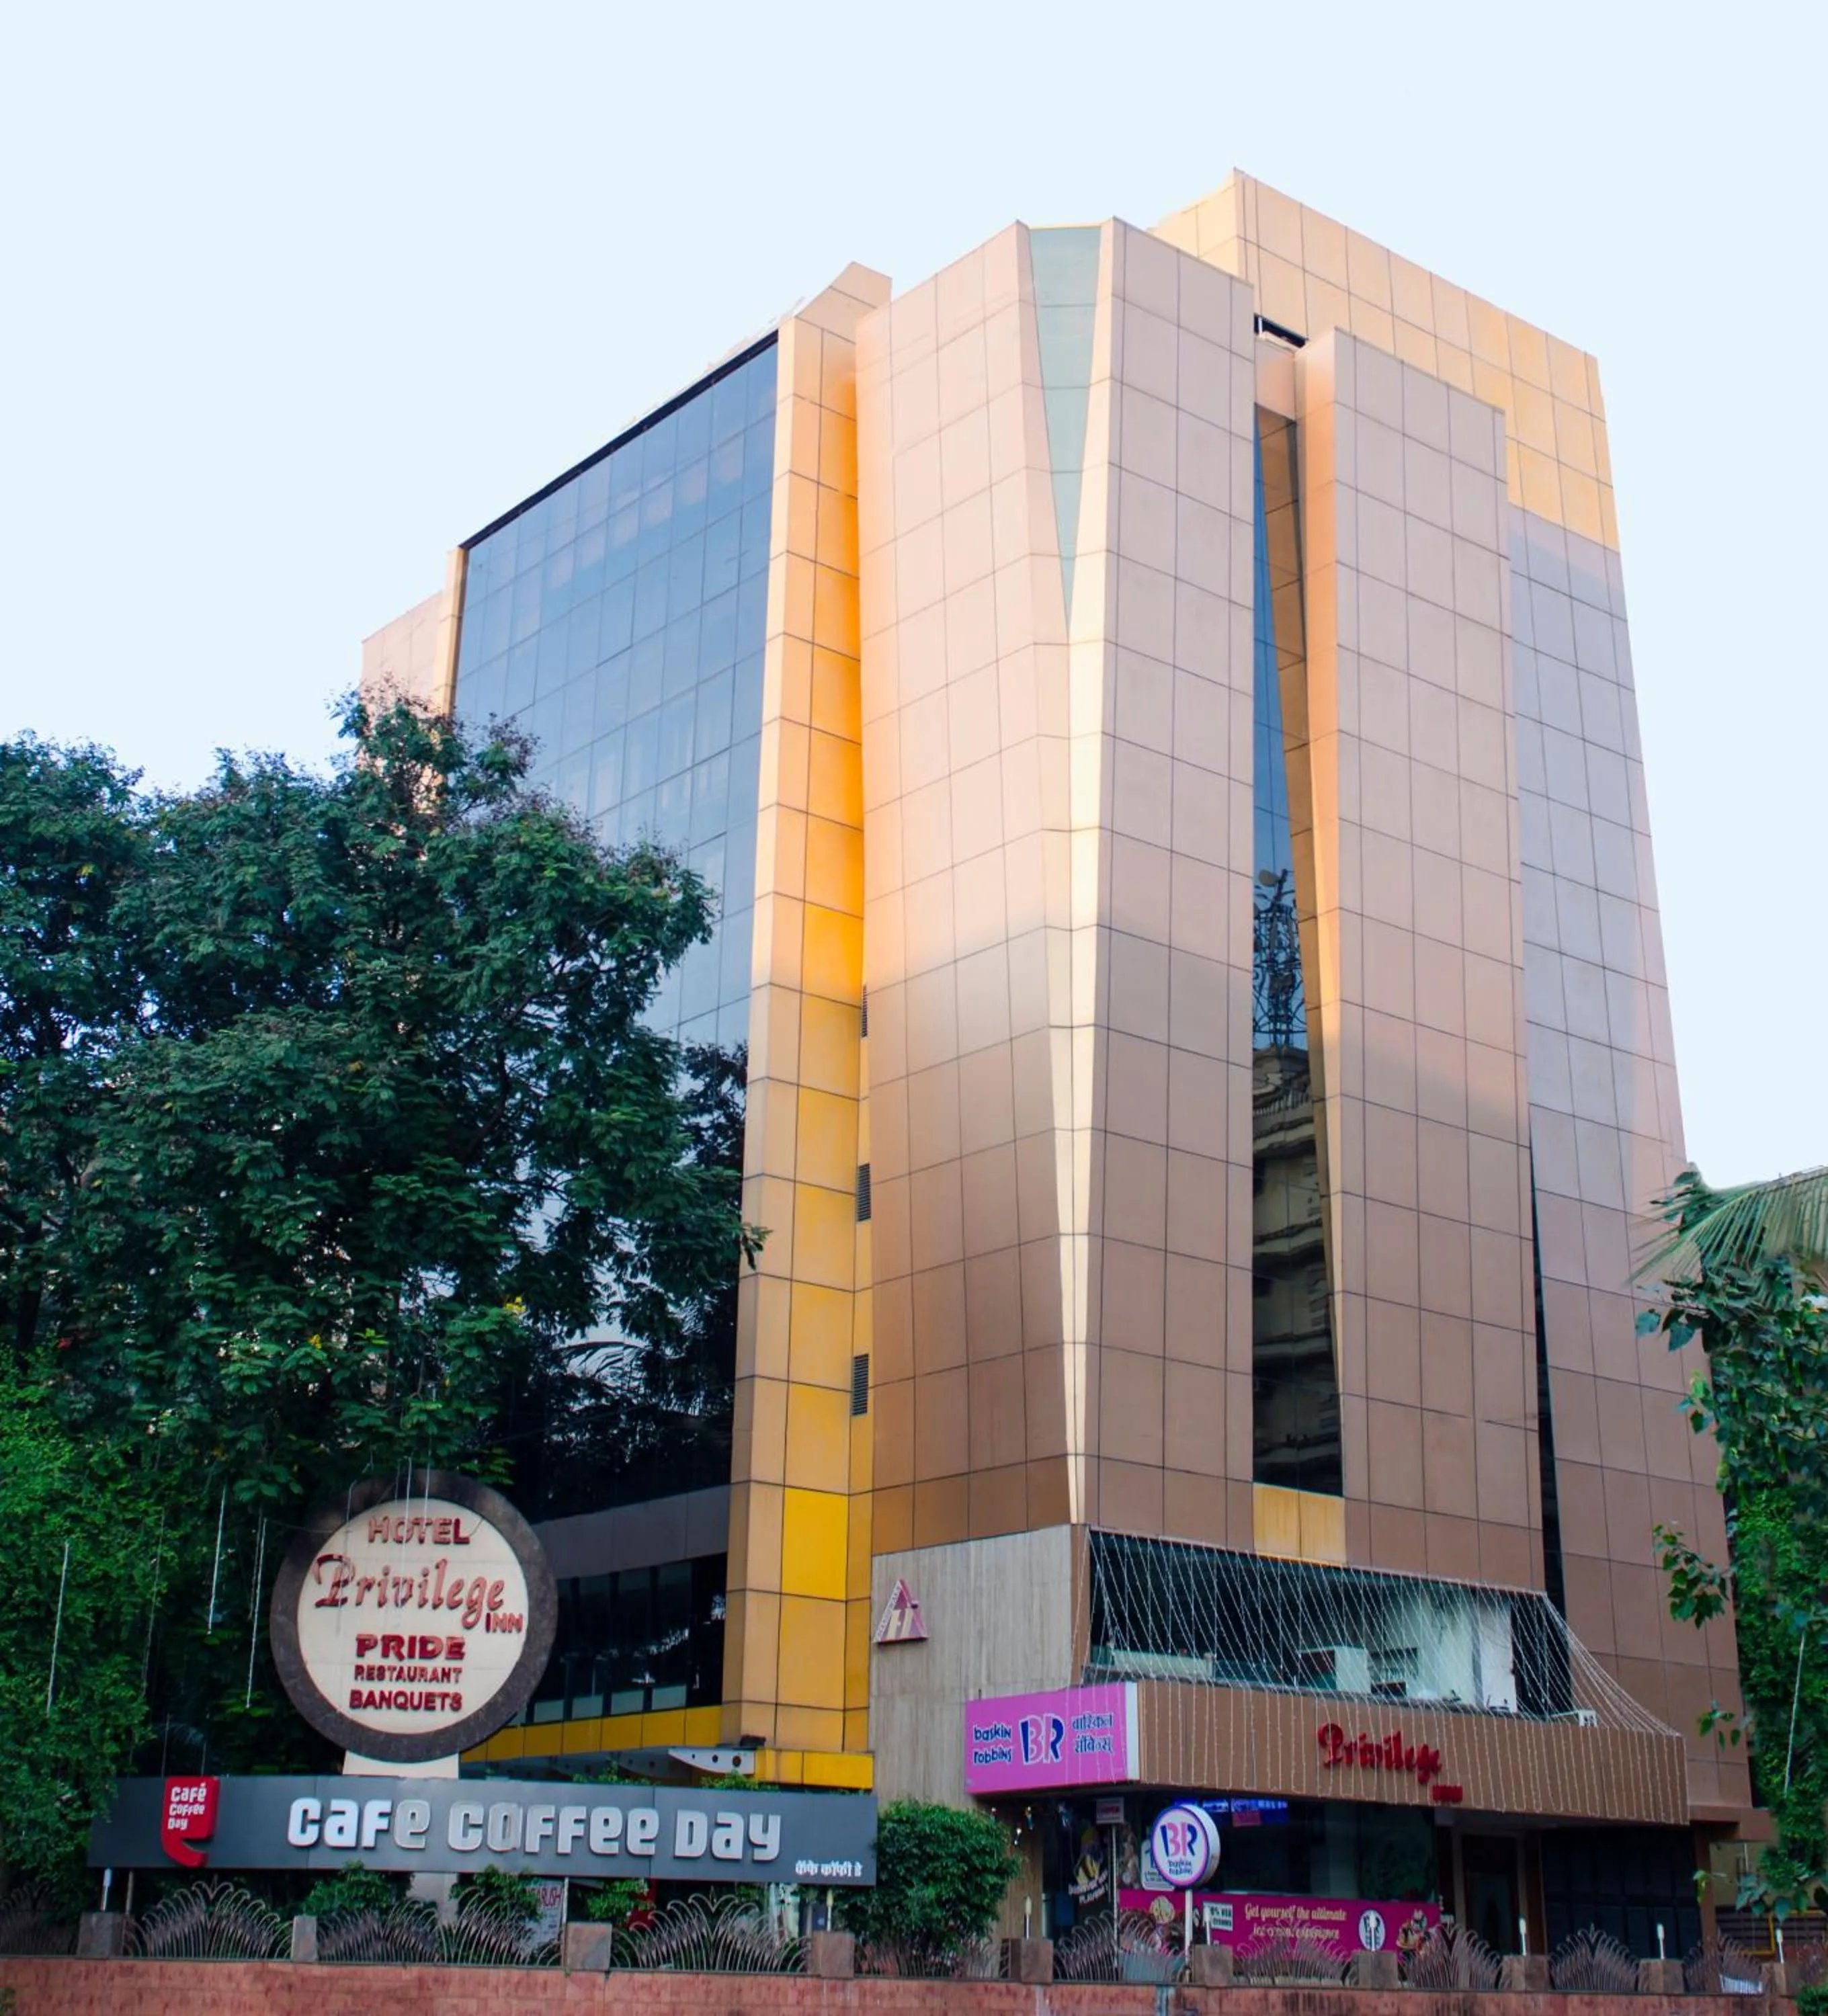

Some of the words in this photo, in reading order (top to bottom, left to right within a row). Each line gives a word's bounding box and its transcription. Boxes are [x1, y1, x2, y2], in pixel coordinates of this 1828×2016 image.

[368, 1515, 470, 1545] HOTEL
[313, 1553, 505, 1631] Privilege
[485, 1613, 524, 1633] INN
[356, 1634, 466, 1661] PRIDE
[354, 1664, 463, 1683] RESTAURANT
[349, 1689, 463, 1712] BANQUETS
[1018, 1714, 1065, 1765] BR
[1159, 1821, 1198, 1857] BR
